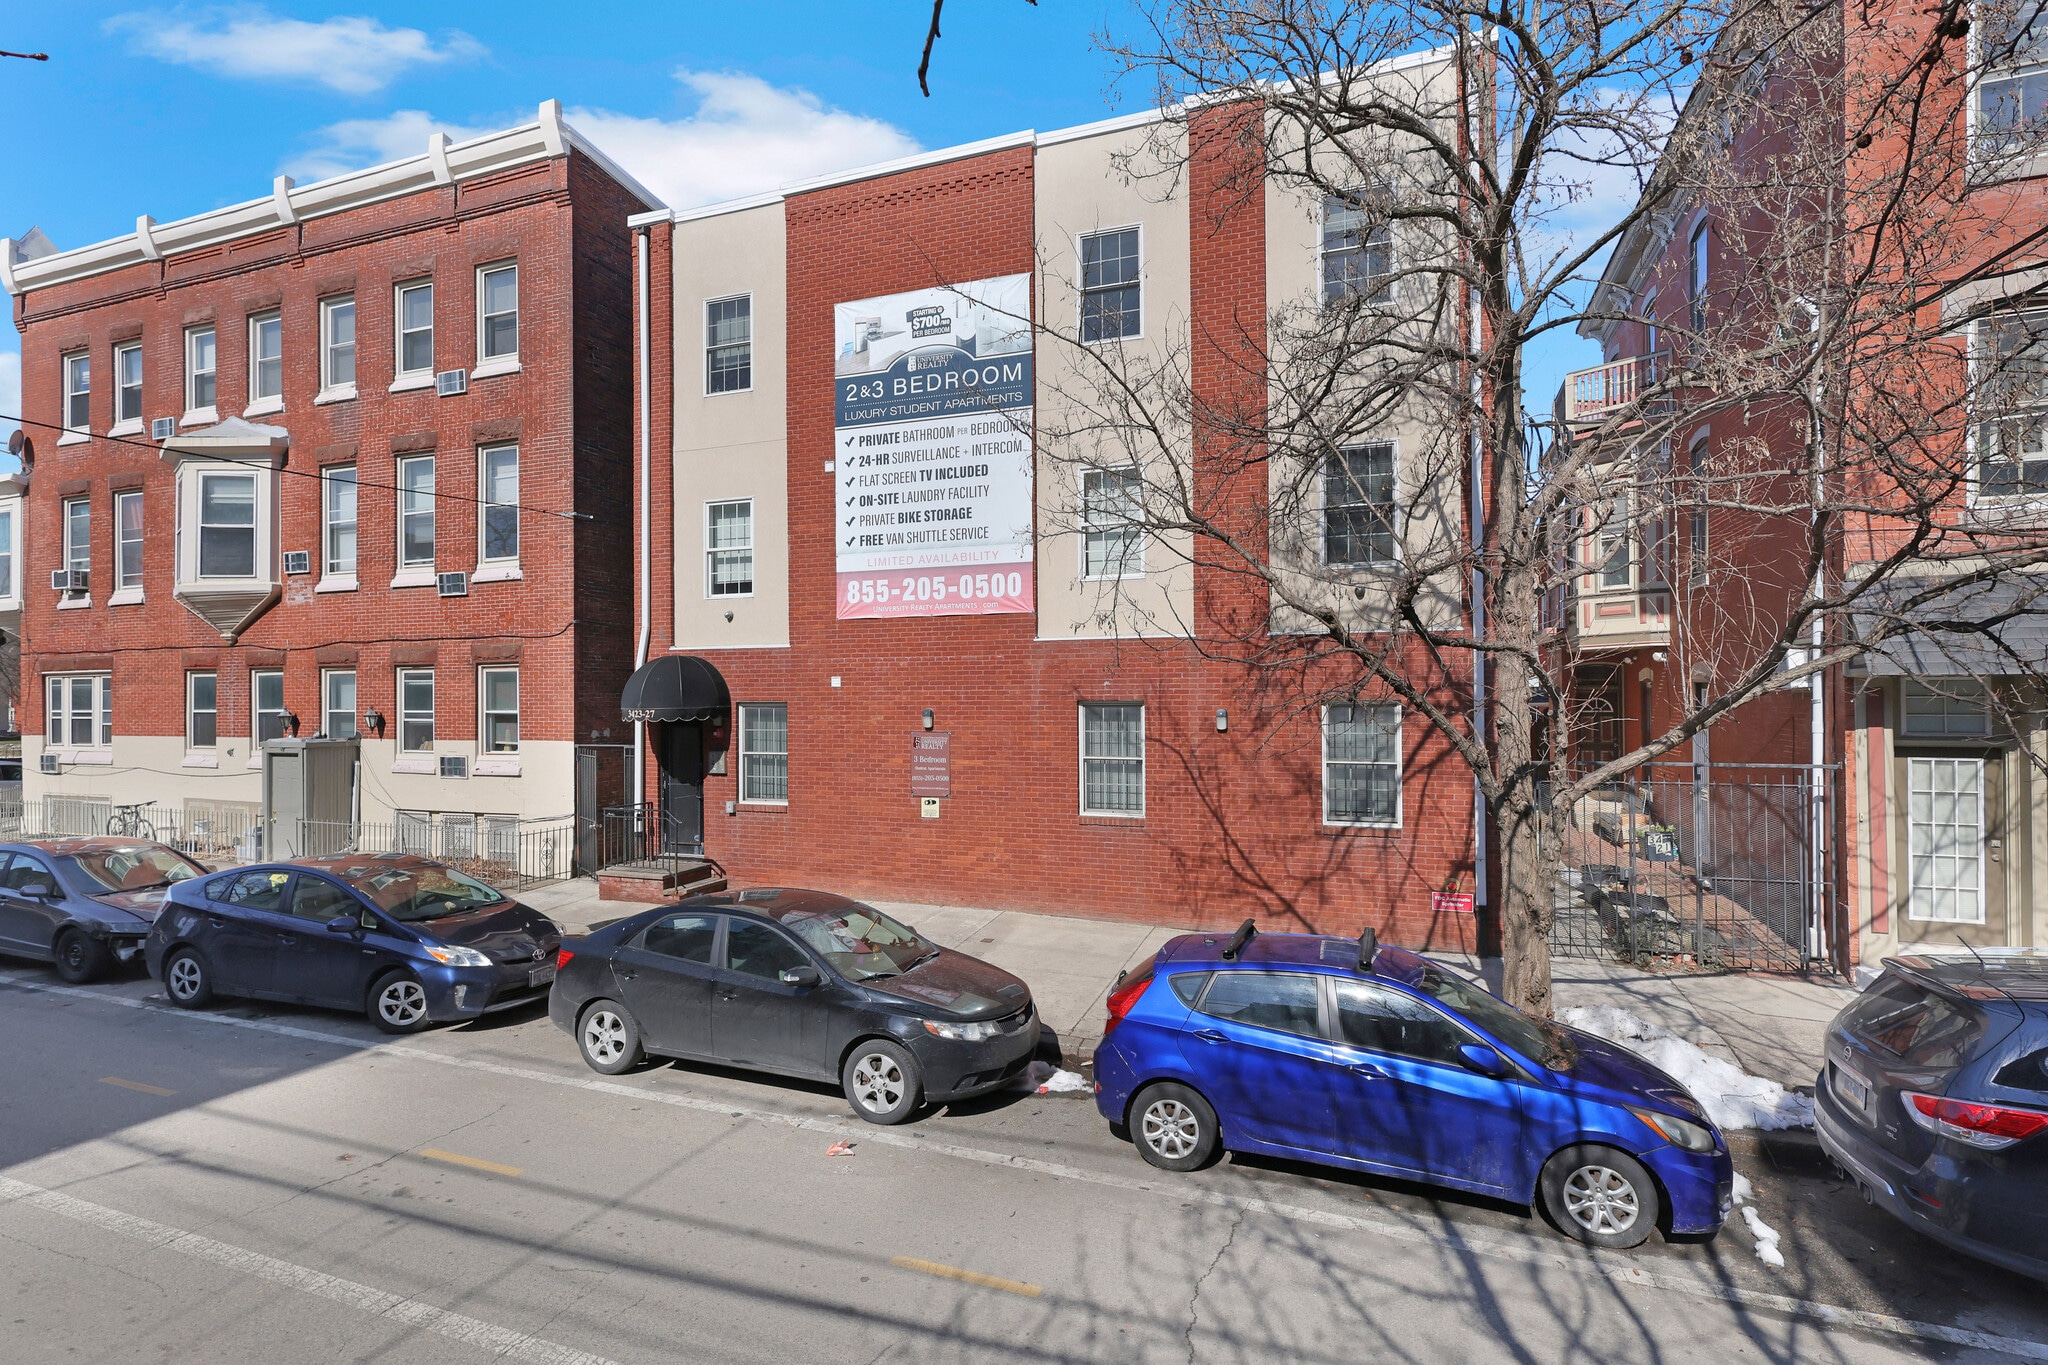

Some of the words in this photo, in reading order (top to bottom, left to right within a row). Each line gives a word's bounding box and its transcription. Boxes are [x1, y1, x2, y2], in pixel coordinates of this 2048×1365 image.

[913, 308, 937, 317] STARTING
[924, 326, 950, 336] BEDROOM
[916, 353, 954, 363] UNIVERSITY
[917, 360, 949, 370] REALTY
[845, 380, 885, 402] 2&3
[893, 362, 1022, 397] BEDROOM
[844, 406, 887, 421] LUXURY
[889, 400, 942, 416] STUDENT
[944, 391, 1023, 410] APARTMENTS
[859, 431, 900, 448] PRIVATE
[902, 425, 955, 443] BATHROOM
[957, 427, 968, 435] PER
[859, 453, 890, 468] 24-HR
[891, 445, 961, 464] SURVEILLANCE
[971, 439, 1022, 457] INTERCOM
[859, 473, 880, 488] FLAT
[882, 470, 917, 486] SCREEN
[919, 469, 934, 482] TV
[935, 464, 989, 481] INCLUDED
[859, 492, 900, 508] ON-SITE
[901, 488, 946, 504] LAUNDRY
[948, 484, 990, 501] FACILITY
[859, 513, 896, 527] PRIVATE
[897, 510, 922, 525] BIKE
[924, 506, 973, 522] STORAGE
[859, 533, 884, 547] FREE
[886, 531, 904, 545] VAN
[906, 528, 947, 544] SHUTTLE
[949, 526, 989, 541] SERVICE
[867, 555, 914, 567] LIMITED
[918, 550, 1000, 565] AVAILABILITY
[847, 572, 1022, 604] 855-205-0500
[627, 710, 655, 718] 3423-27
[914, 755, 918, 763] 3
[919, 755, 947, 763] Bedroom
